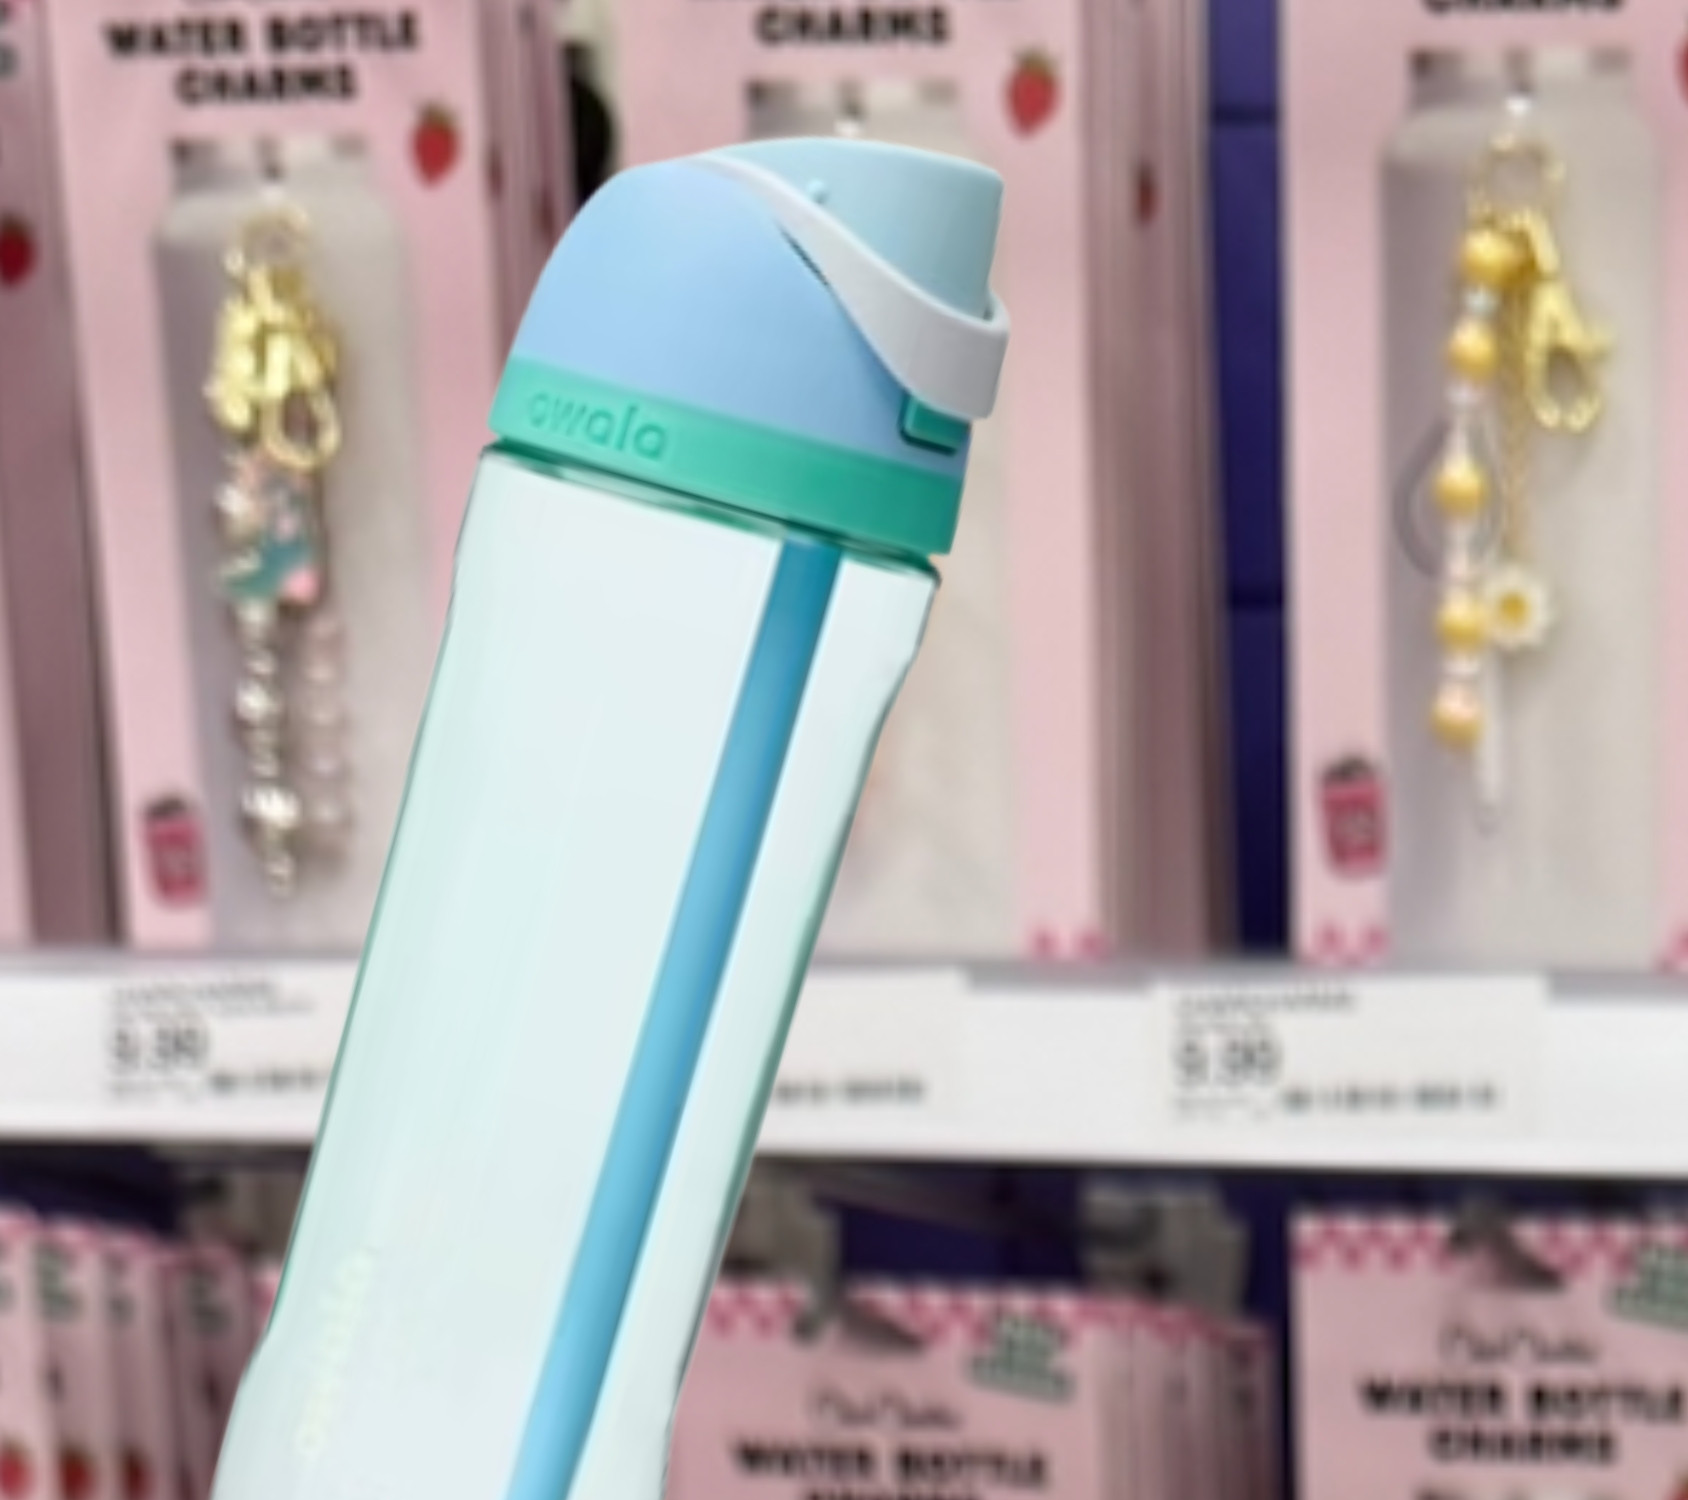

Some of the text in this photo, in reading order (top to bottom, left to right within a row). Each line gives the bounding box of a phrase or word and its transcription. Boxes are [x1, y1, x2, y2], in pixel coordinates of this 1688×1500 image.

[104, 11, 418, 57] WATER BOTTLE
[754, 5, 951, 46] CHARMS
[176, 66, 357, 103] CHARMS
[526, 388, 669, 464] owala
[1357, 1378, 1686, 1425] WATER BOTTLE
[730, 1440, 1048, 1489] WATER BOTTLE
[1430, 1427, 1616, 1466] CHARMS
